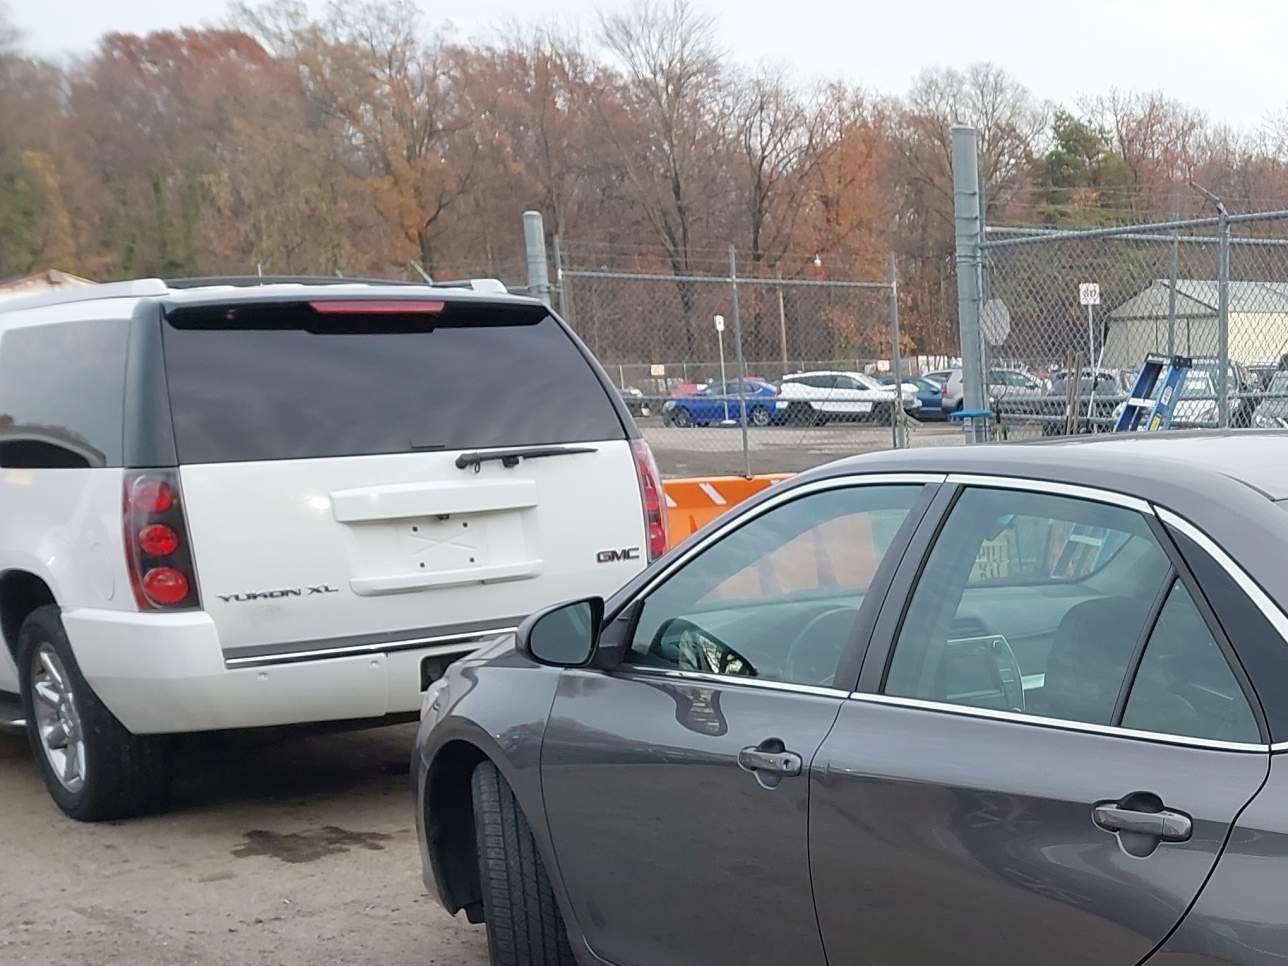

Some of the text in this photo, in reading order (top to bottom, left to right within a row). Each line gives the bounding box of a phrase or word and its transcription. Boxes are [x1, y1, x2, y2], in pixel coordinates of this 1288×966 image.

[597, 547, 640, 563] GMC
[216, 585, 339, 602] YUKON XL
